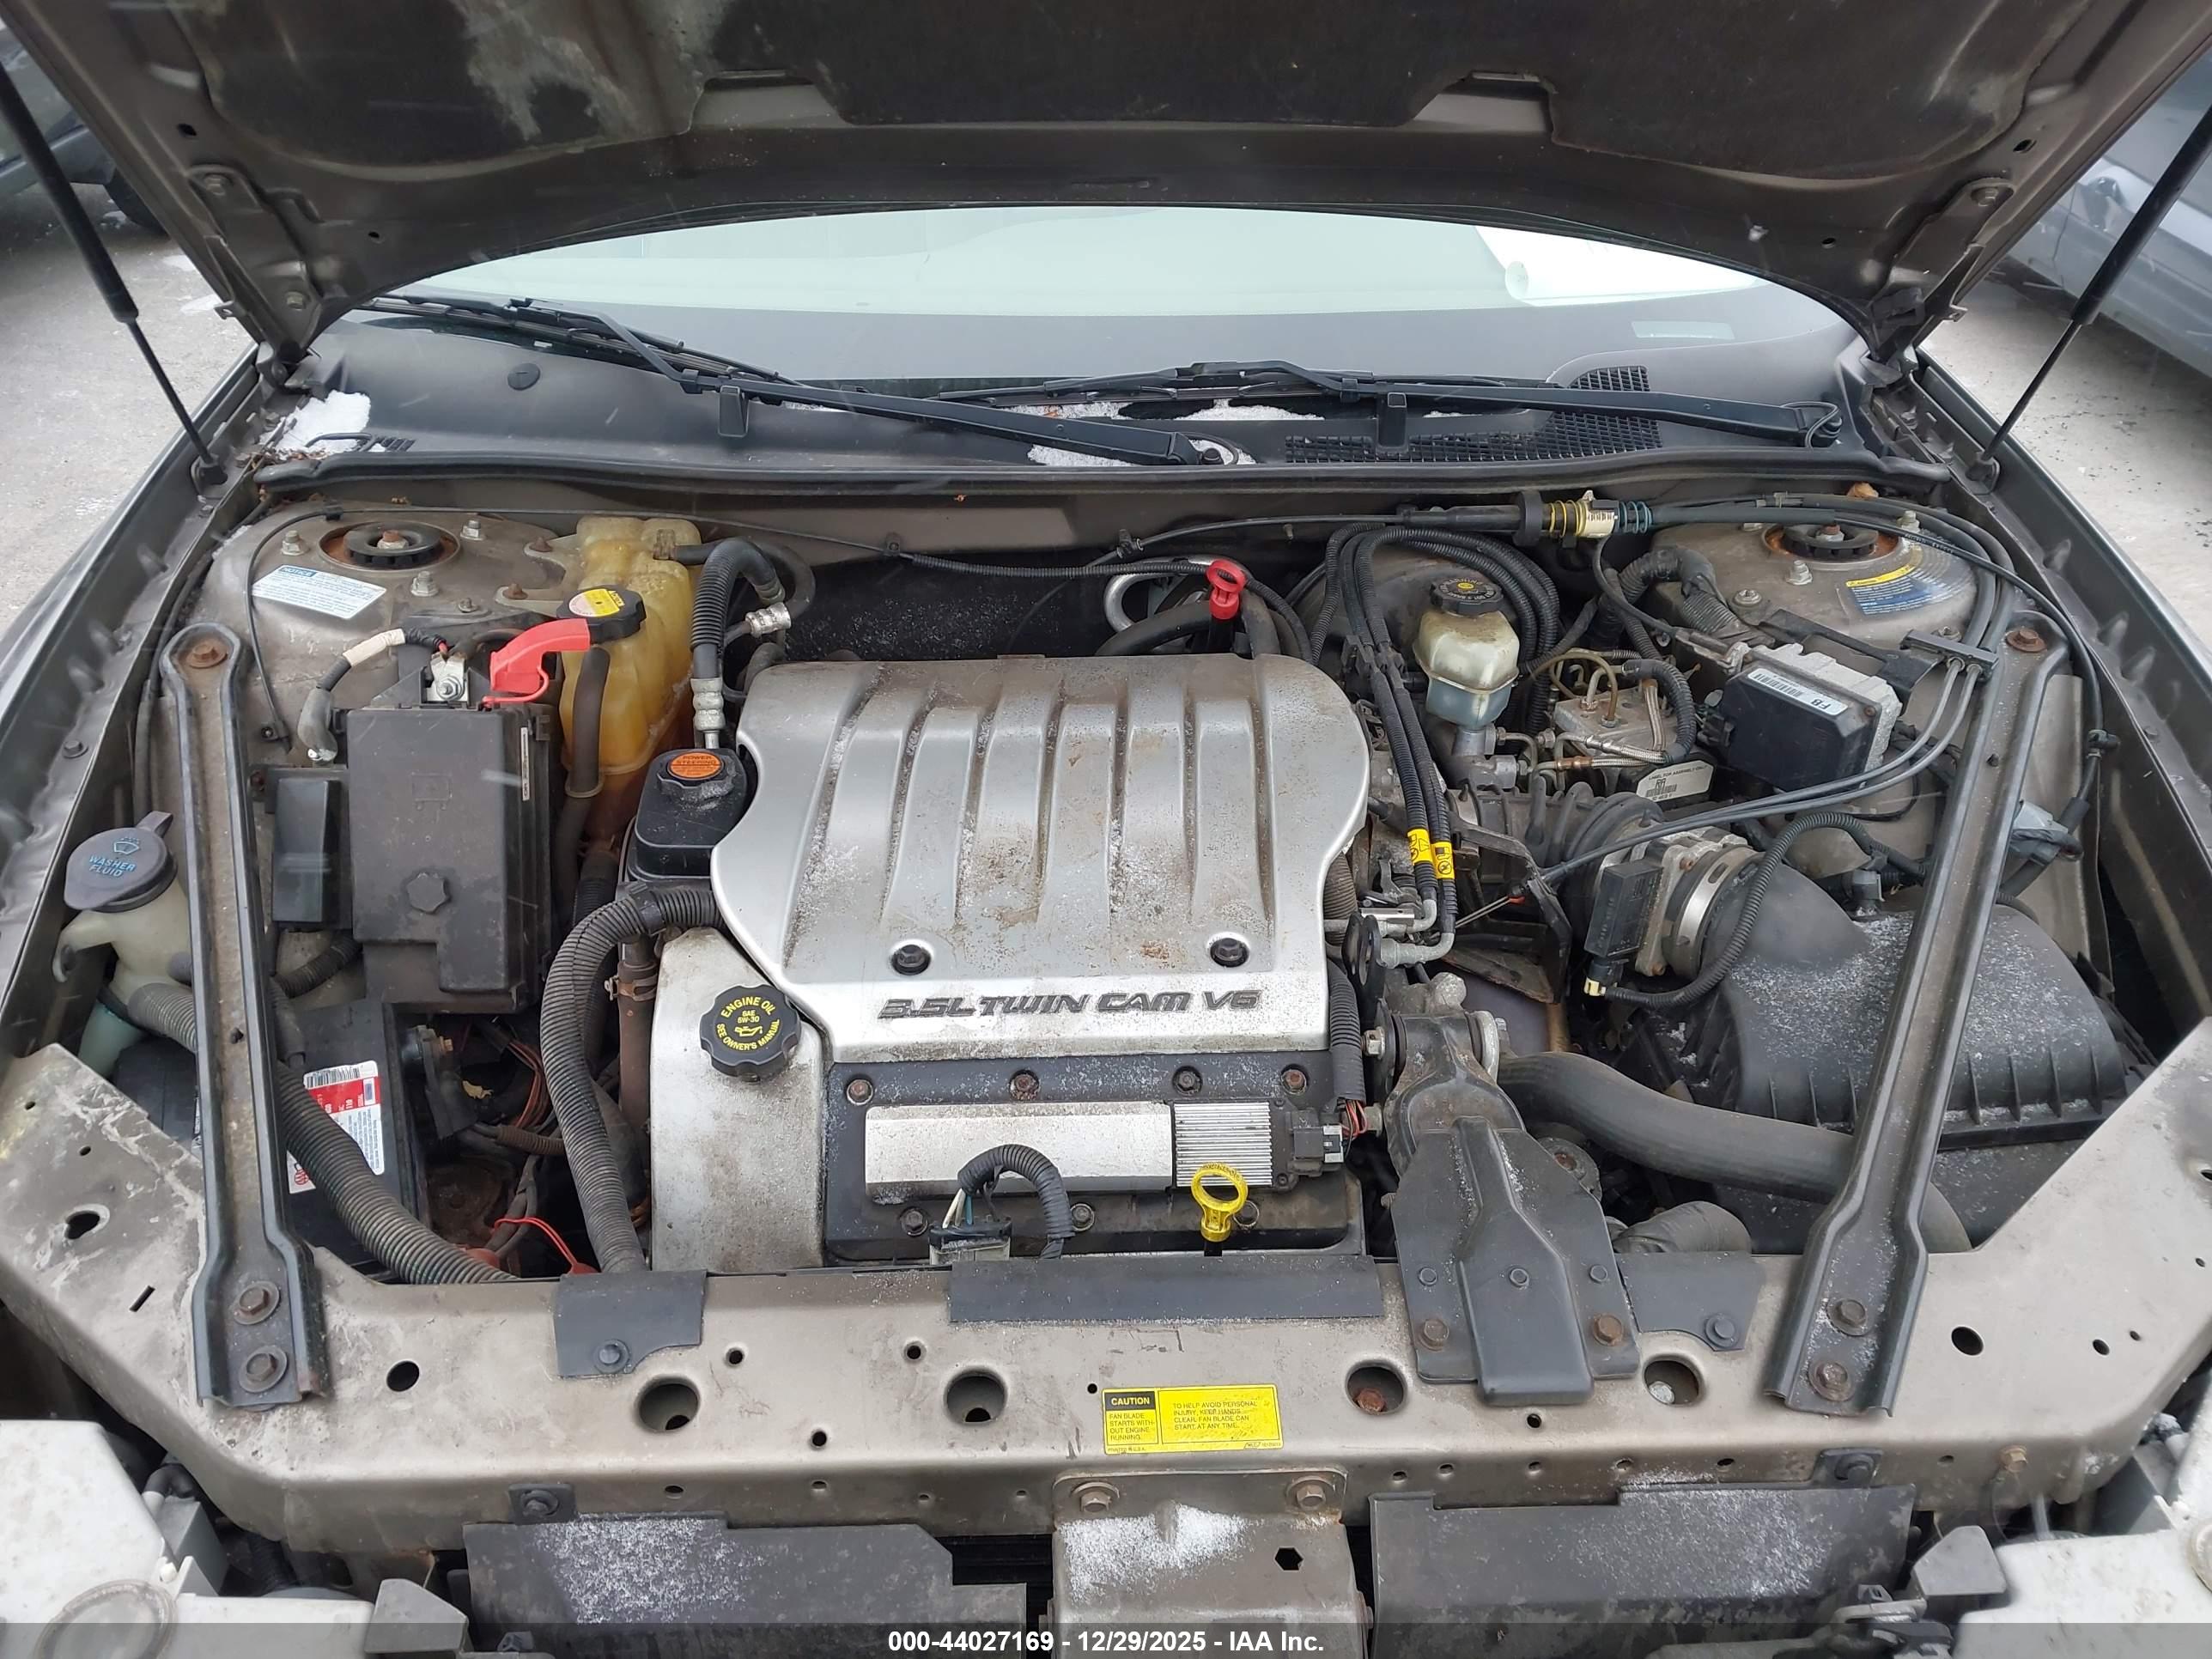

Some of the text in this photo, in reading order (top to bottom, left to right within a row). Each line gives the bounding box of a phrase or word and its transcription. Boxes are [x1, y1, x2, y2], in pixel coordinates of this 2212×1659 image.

[1811, 698, 1831, 709] FB
[88, 855, 137, 872] WASHER
[88, 864, 124, 878] FLUID
[720, 996, 776, 1018] ENGINE OIL
[878, 989, 1262, 1019] 3.5L TWIN CAM V6
[716, 1019, 780, 1051] SEE OWNER'S MANUAL
[1110, 1397, 1151, 1406] CAUTION
